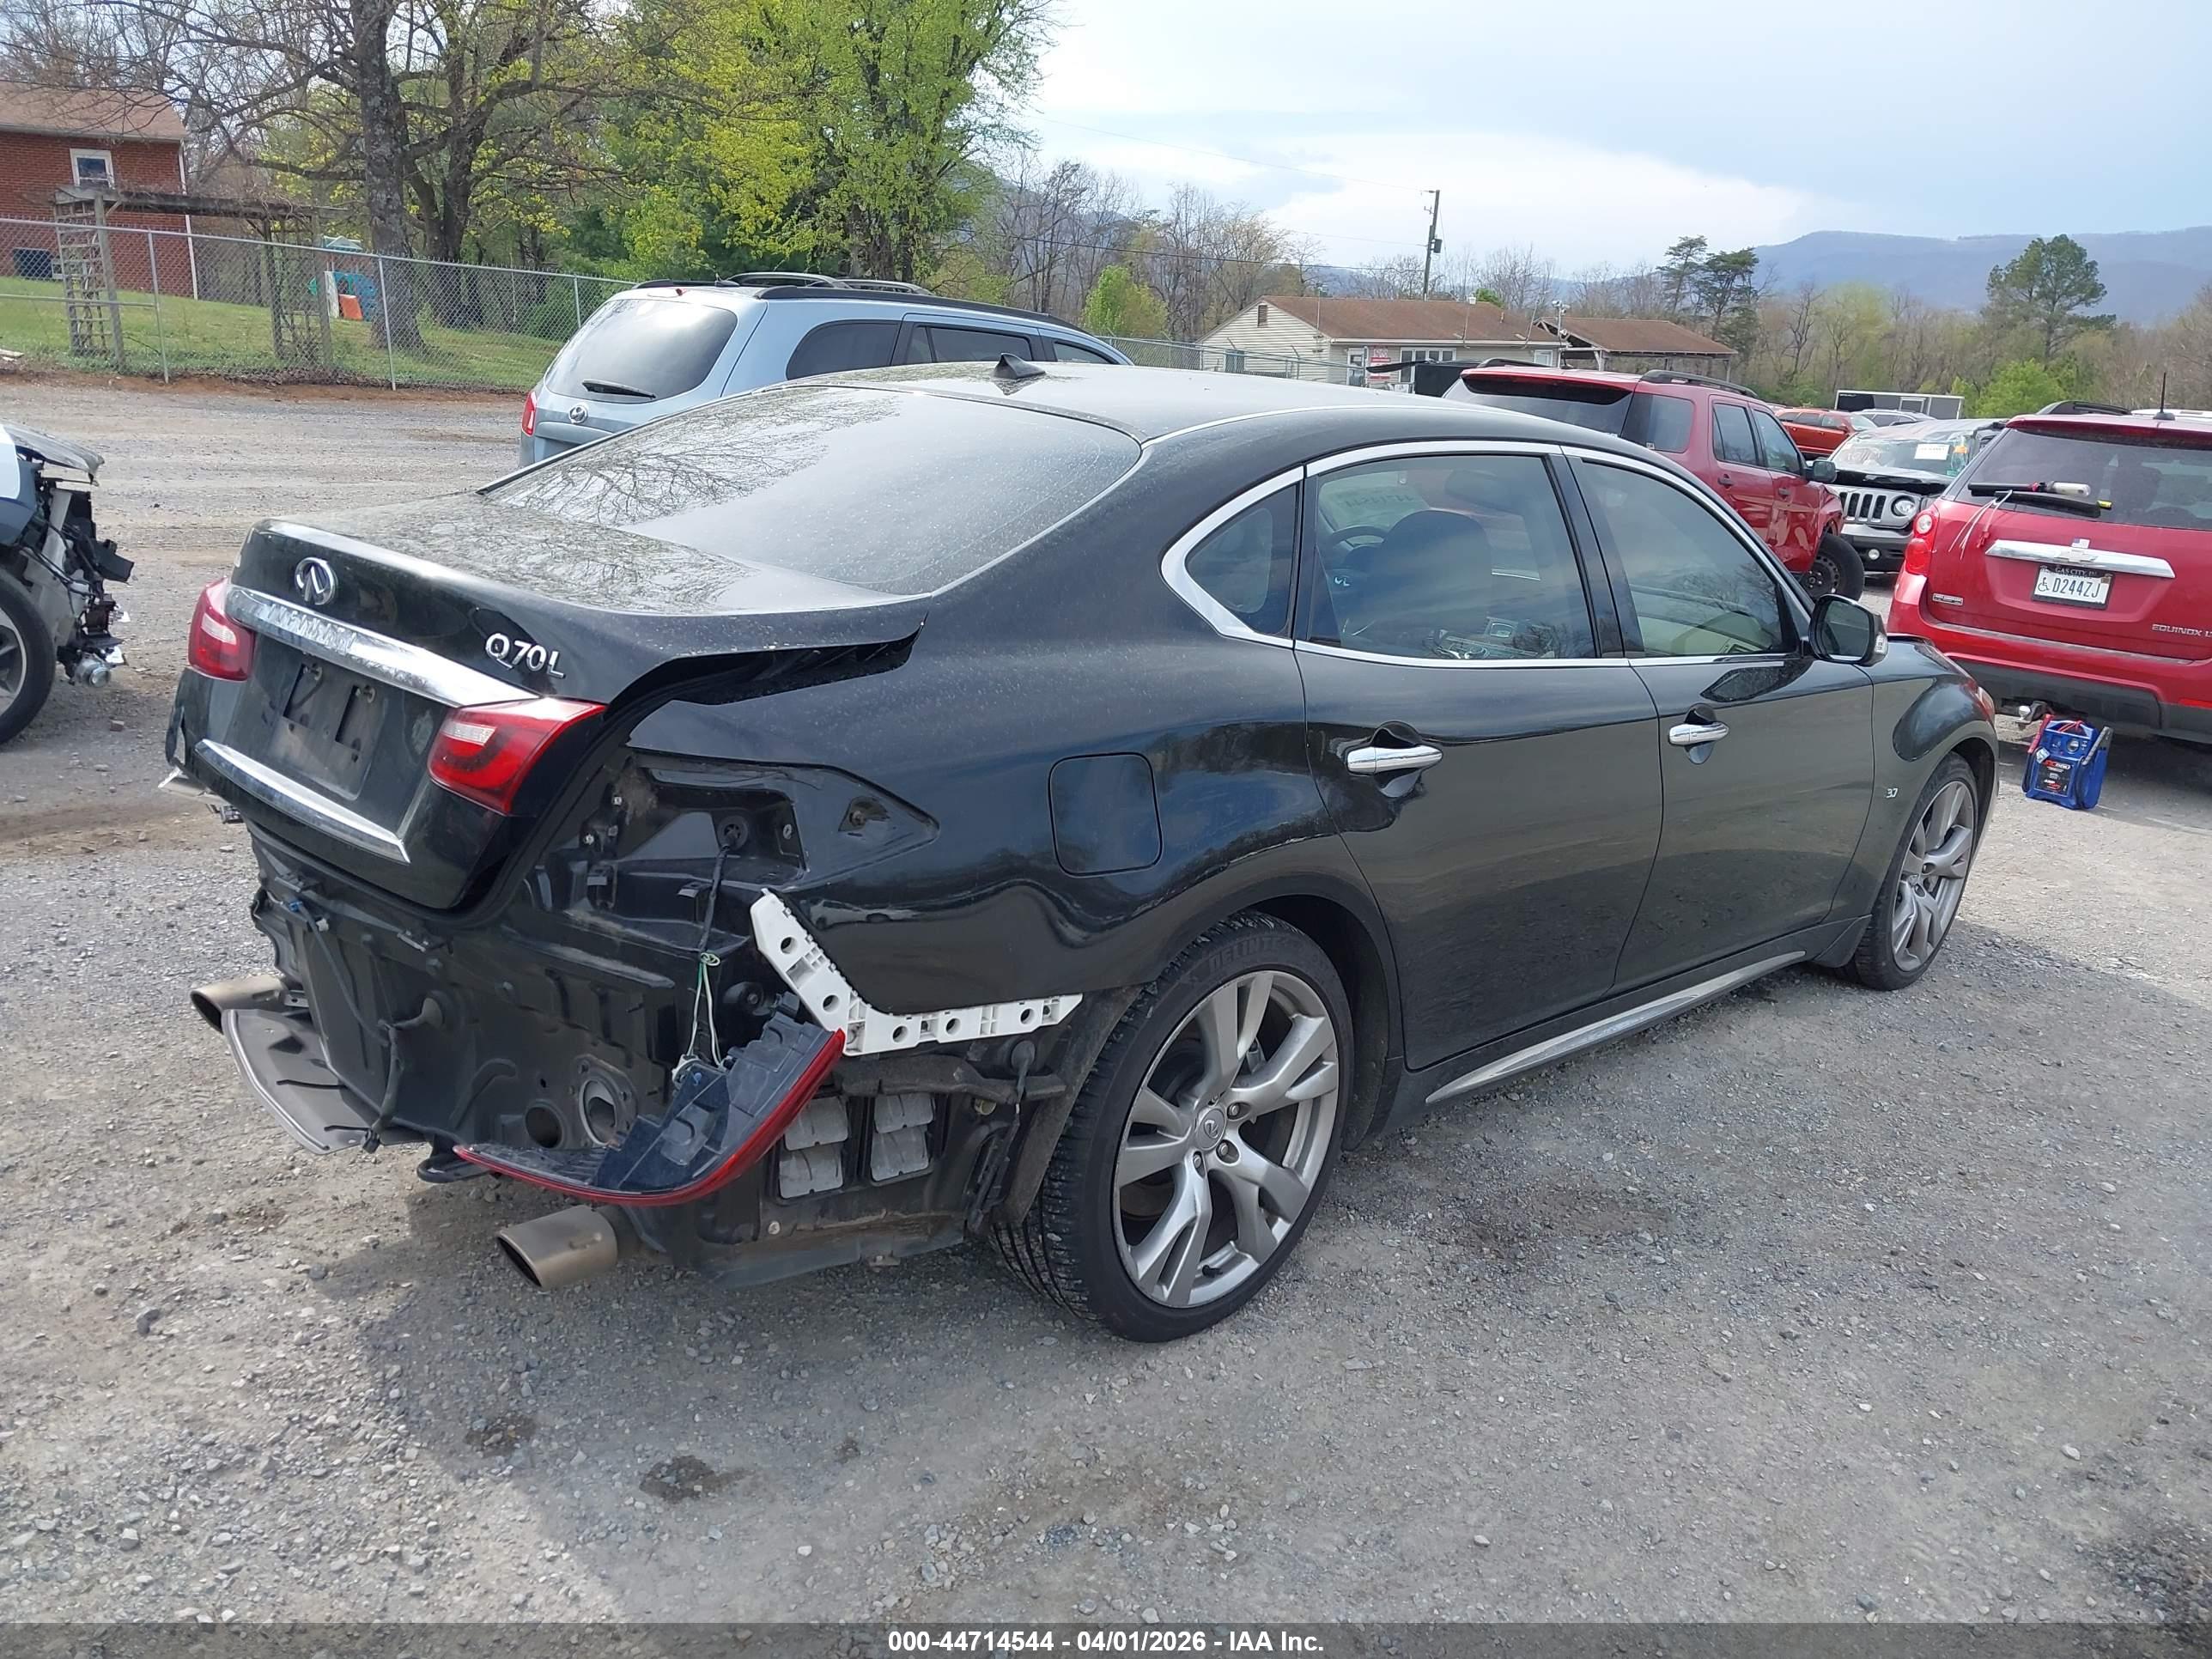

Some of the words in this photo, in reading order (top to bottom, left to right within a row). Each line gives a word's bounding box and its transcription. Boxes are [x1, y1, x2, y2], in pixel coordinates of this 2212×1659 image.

[2052, 577, 2101, 599] D244ZJ
[2152, 623, 2203, 636] EQUINOX
[485, 633, 566, 678] Q70L
